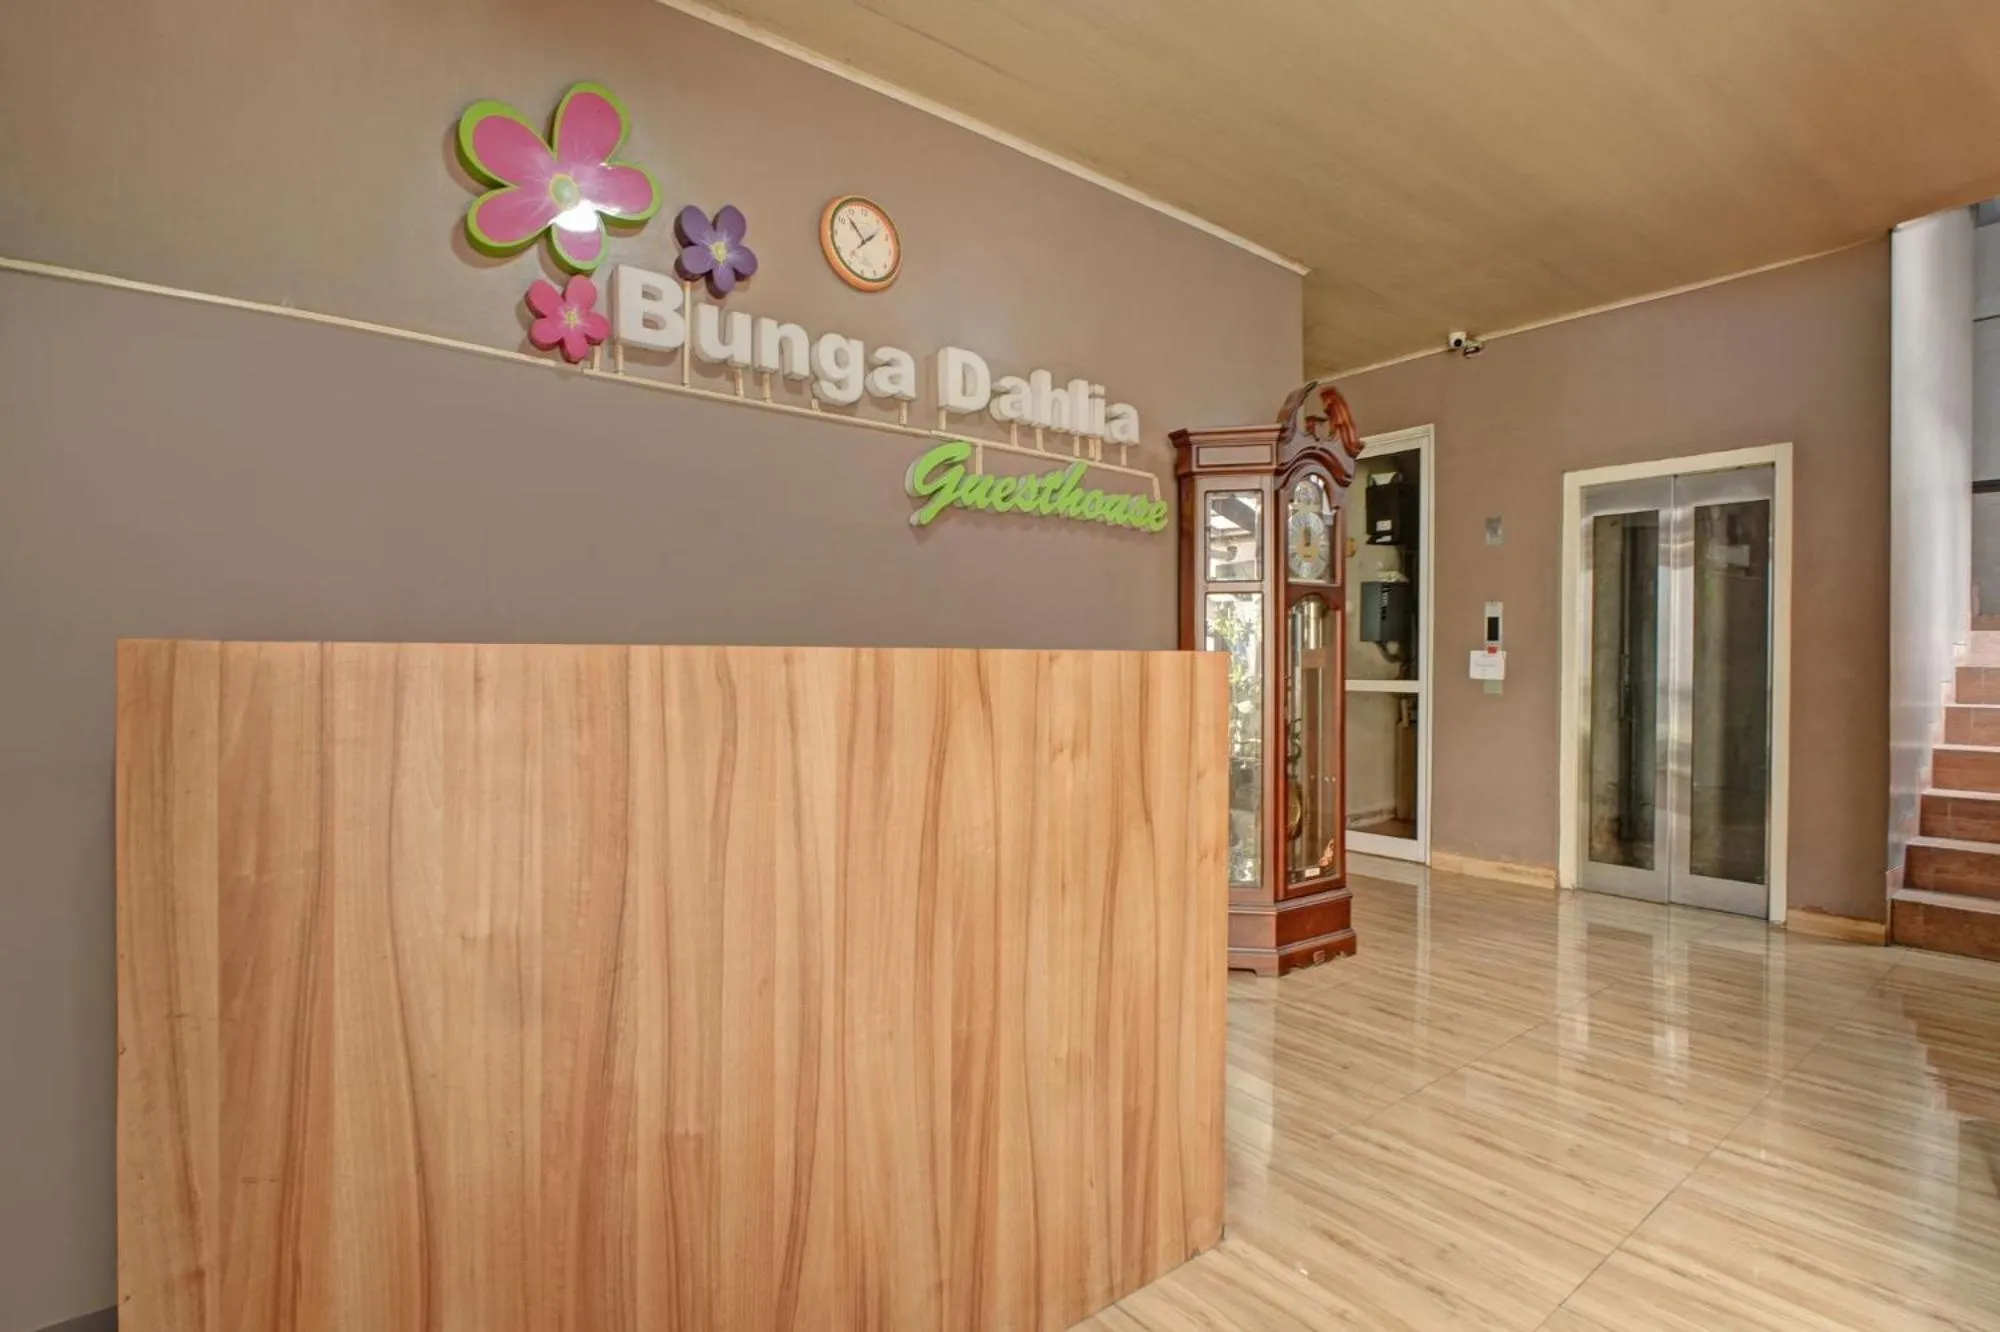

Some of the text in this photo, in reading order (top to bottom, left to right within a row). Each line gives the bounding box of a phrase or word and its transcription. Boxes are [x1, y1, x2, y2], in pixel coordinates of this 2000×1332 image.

[609, 264, 1139, 446] Bunga Dahlia
[905, 441, 1168, 532] Guesthouse
